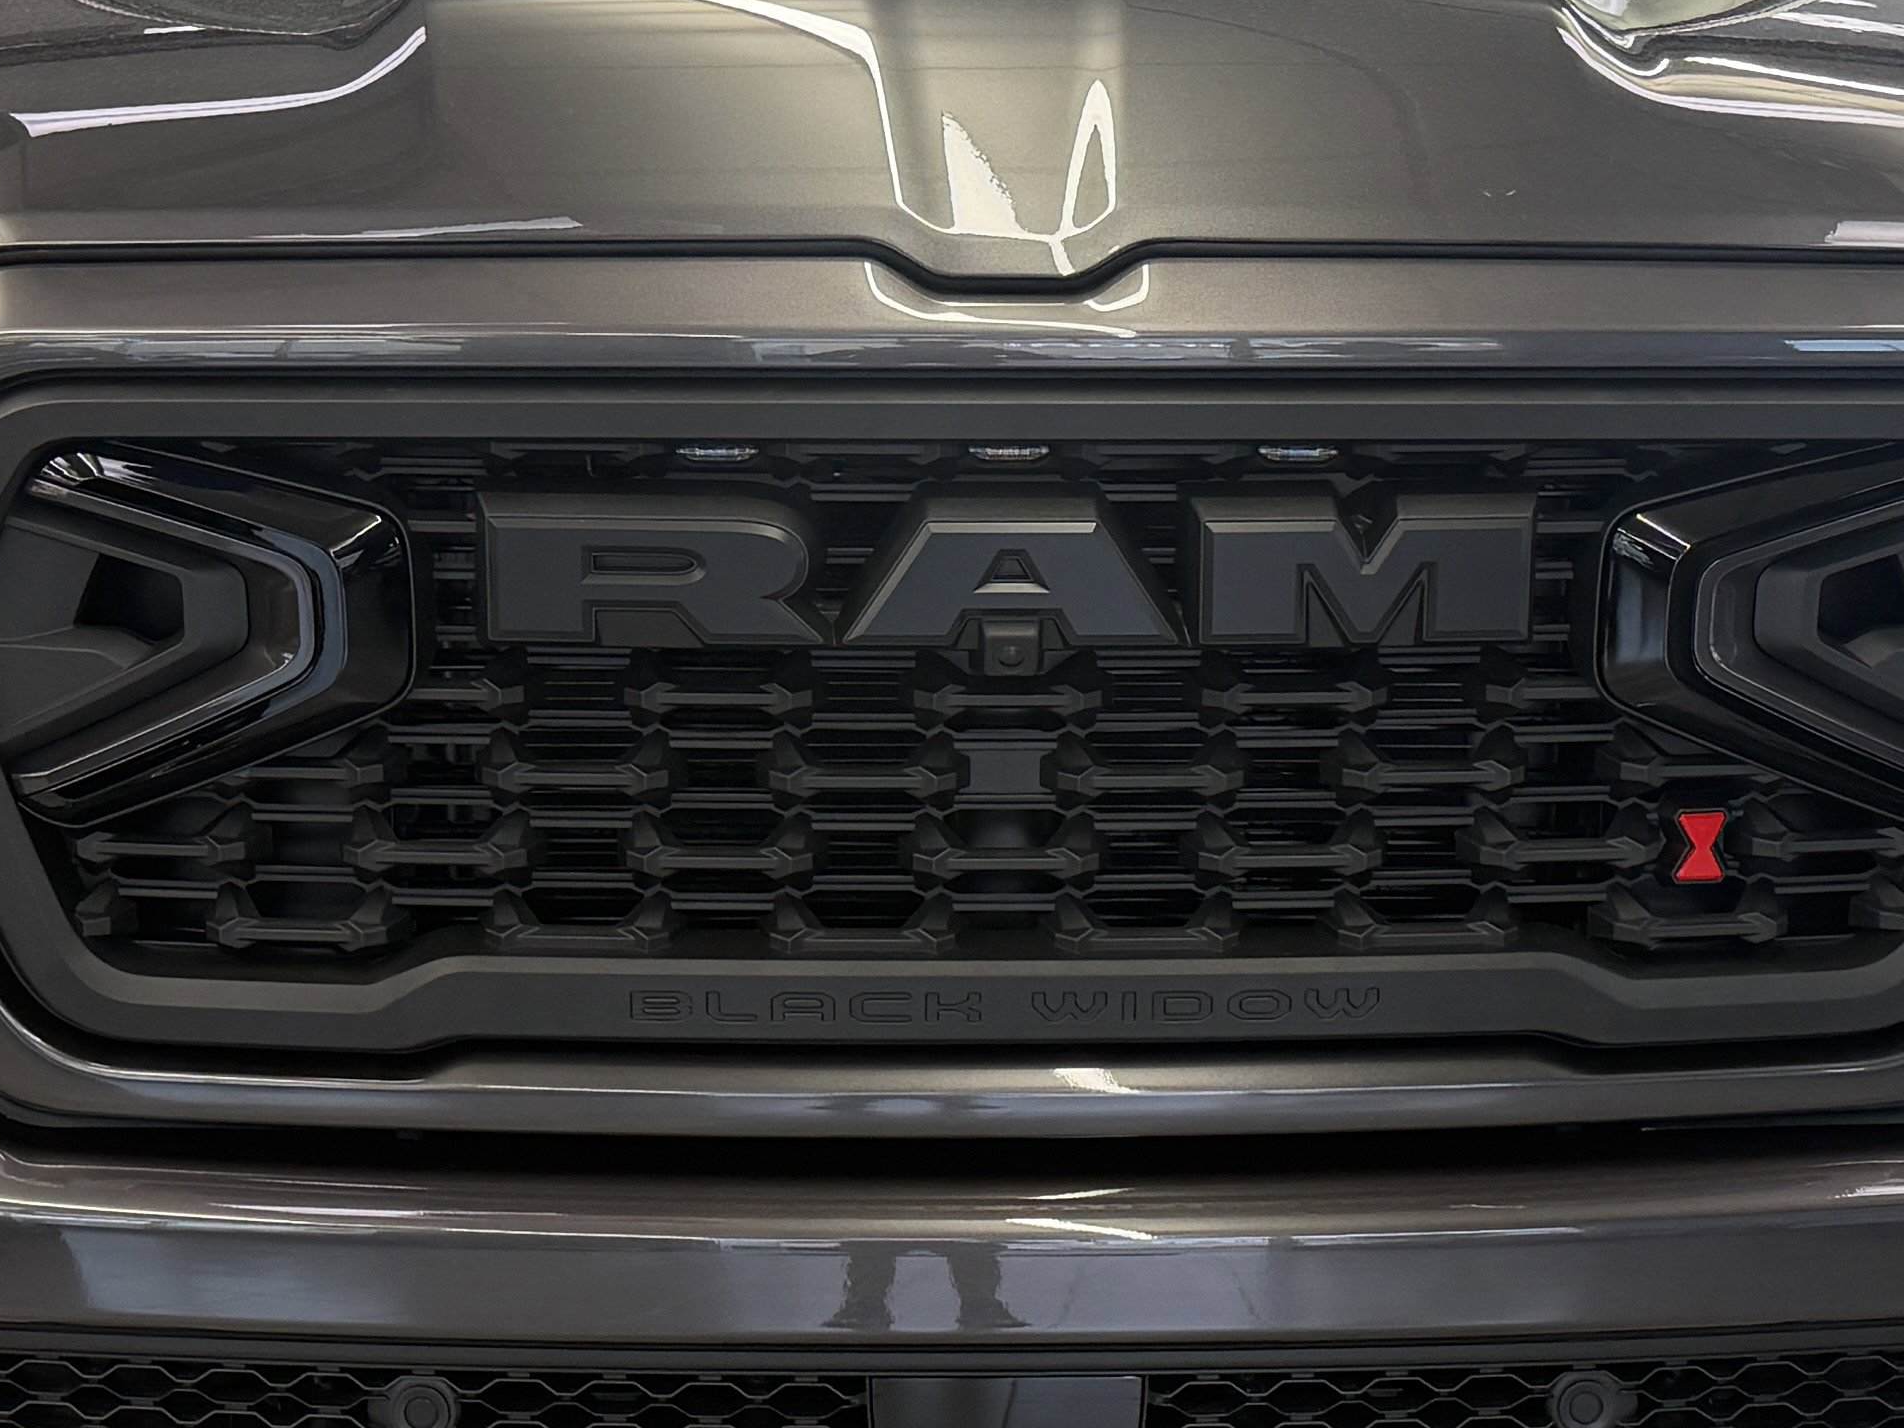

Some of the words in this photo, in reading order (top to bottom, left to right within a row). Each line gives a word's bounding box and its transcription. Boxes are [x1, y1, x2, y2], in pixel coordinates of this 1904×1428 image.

[482, 496, 1538, 649] RAM
[628, 990, 983, 1024] BLACK
[1031, 986, 1382, 1023] WIDOW
